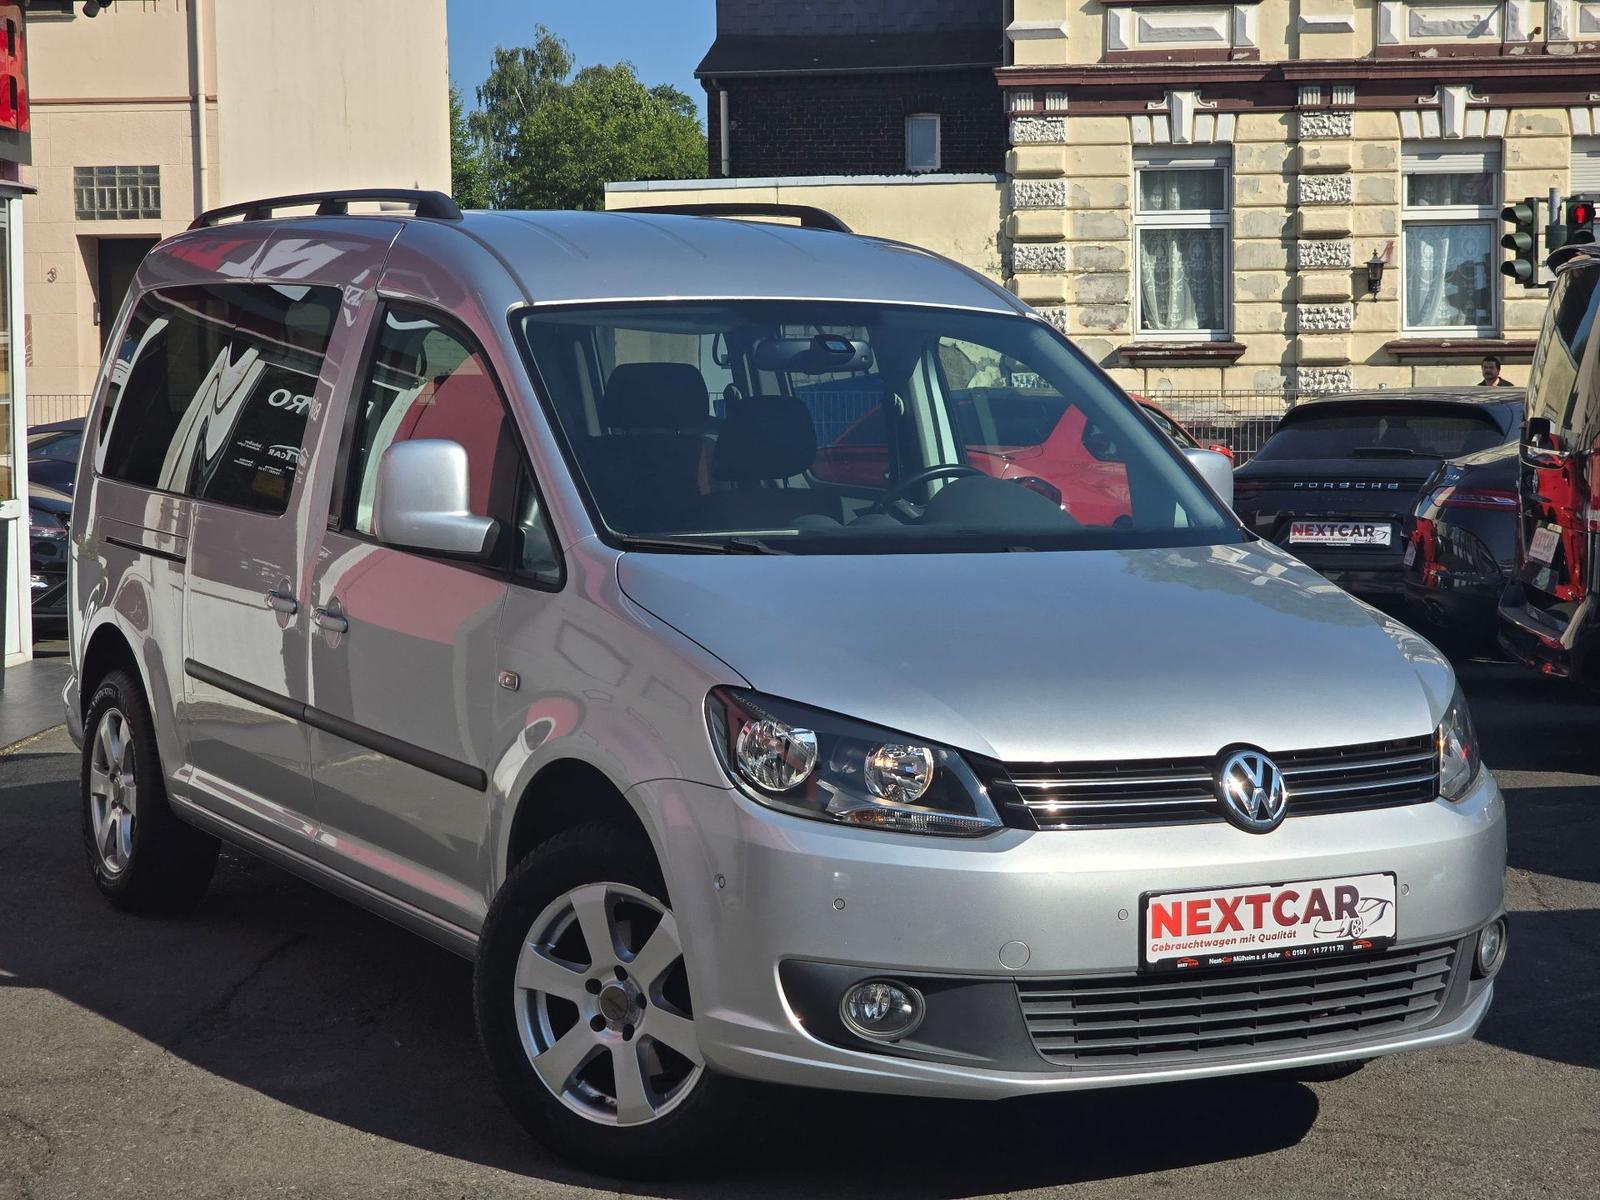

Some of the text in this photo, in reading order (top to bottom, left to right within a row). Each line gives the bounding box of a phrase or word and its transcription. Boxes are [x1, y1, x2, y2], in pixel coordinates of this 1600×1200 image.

[1292, 524, 1375, 537] NEXTCAR
[1151, 884, 1360, 940] NEXTCAR
[1151, 930, 1297, 952] Gebrauchtwagen mit Qualität
